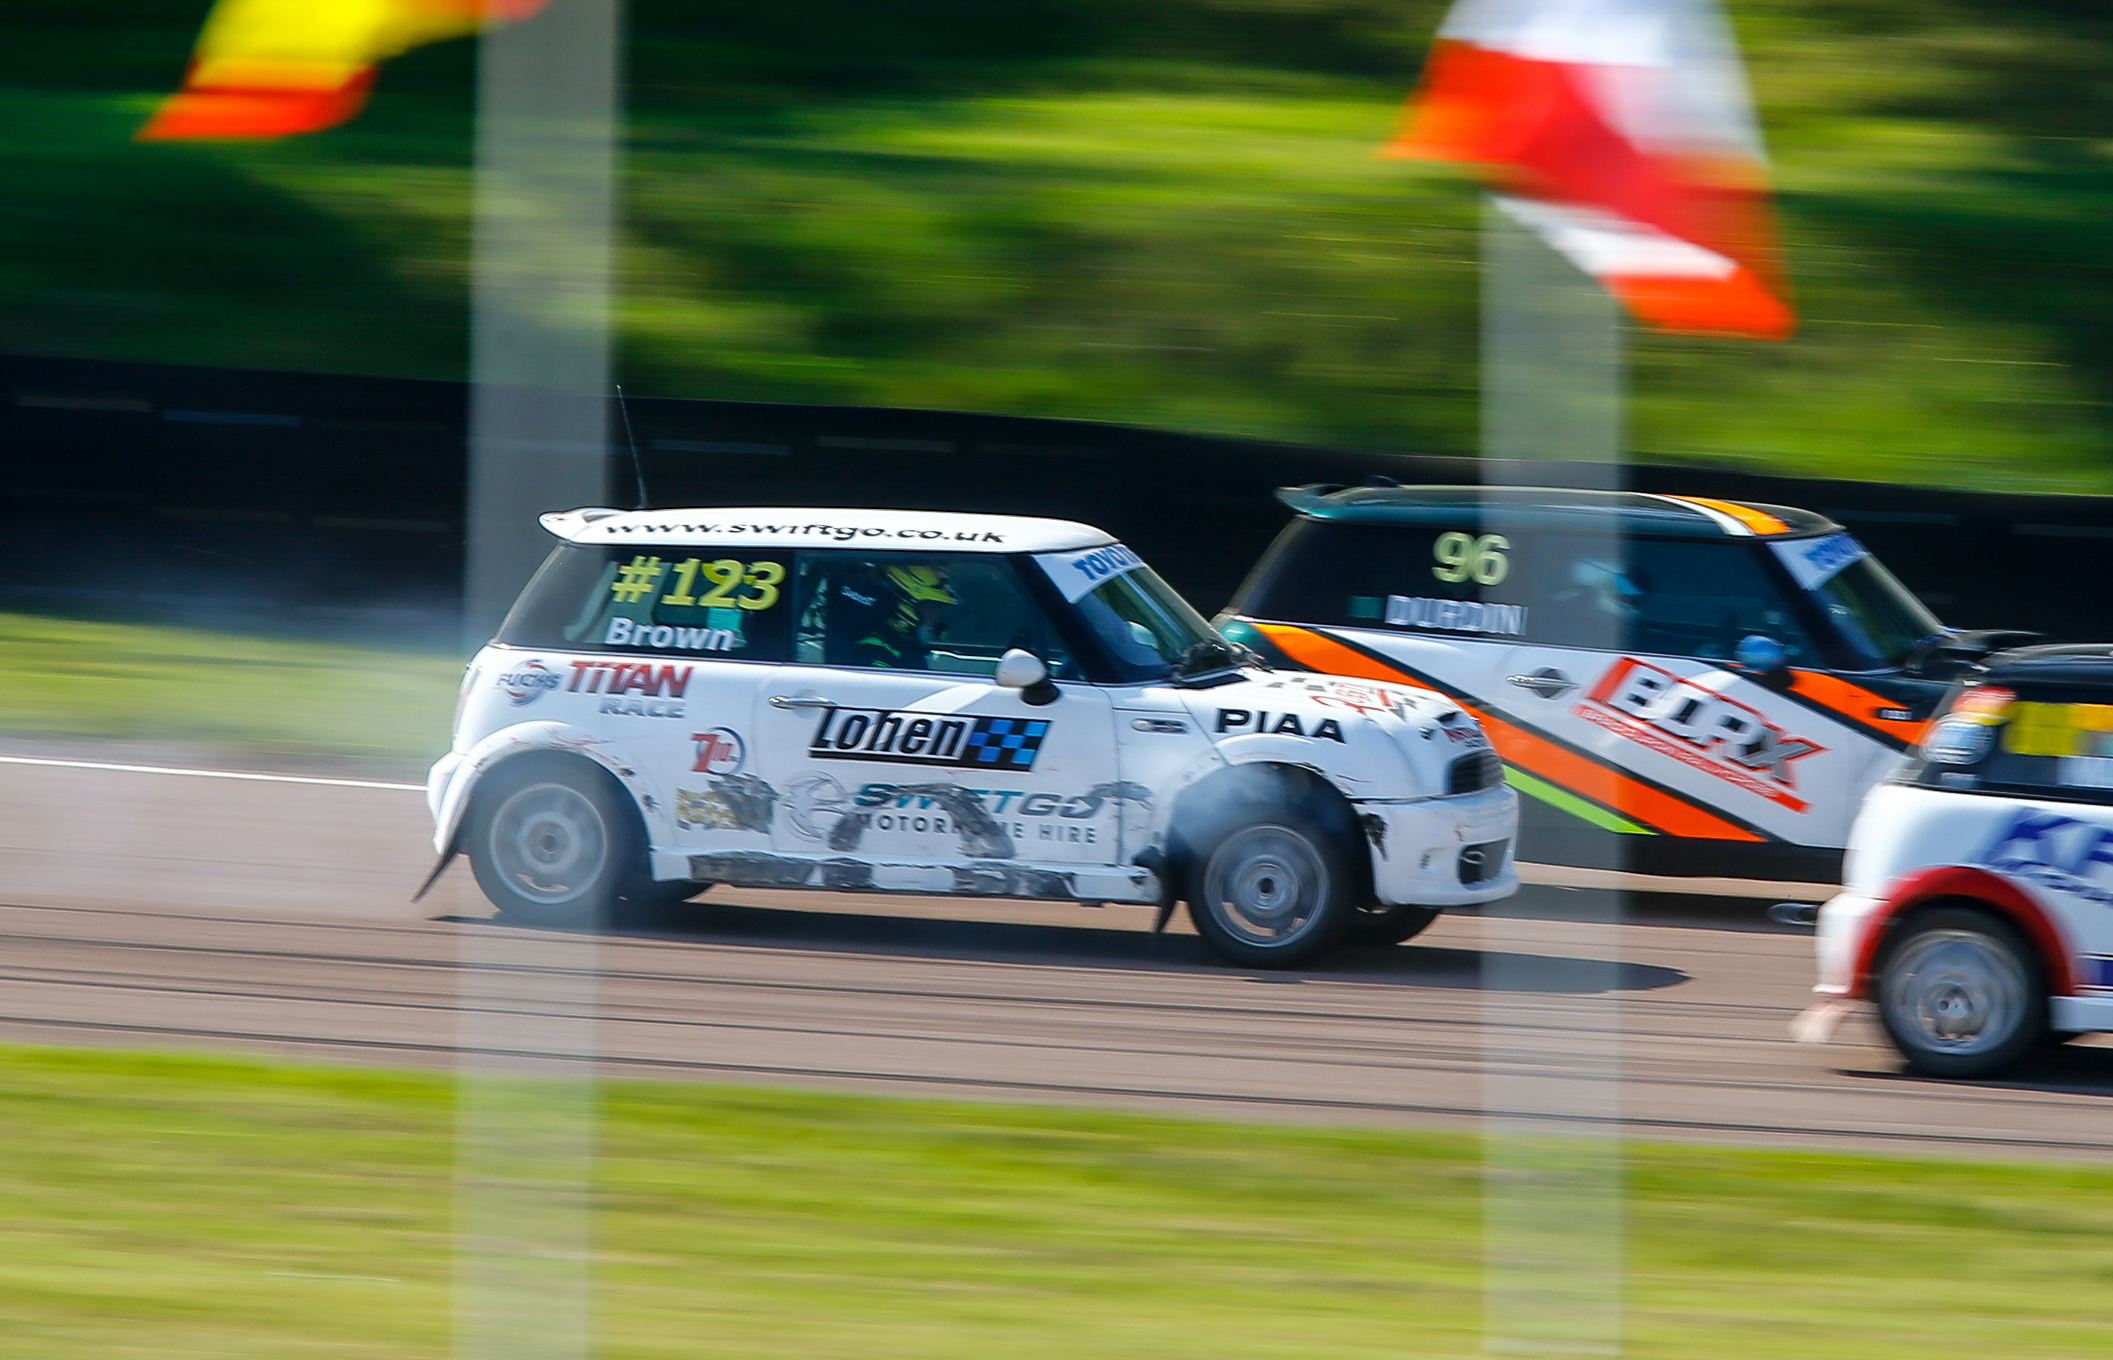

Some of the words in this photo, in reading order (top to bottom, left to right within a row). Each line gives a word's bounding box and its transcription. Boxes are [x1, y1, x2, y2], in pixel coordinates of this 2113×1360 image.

[605, 522, 1005, 544] www.swiftgo.co.uk
[1431, 531, 1512, 586] 96
[610, 555, 786, 611] #123
[604, 616, 734, 652] Brown
[598, 698, 687, 718] RACE
[1213, 707, 1346, 744] PIAA
[814, 707, 968, 758] Lohen
[1038, 822, 1097, 844] HIRE
